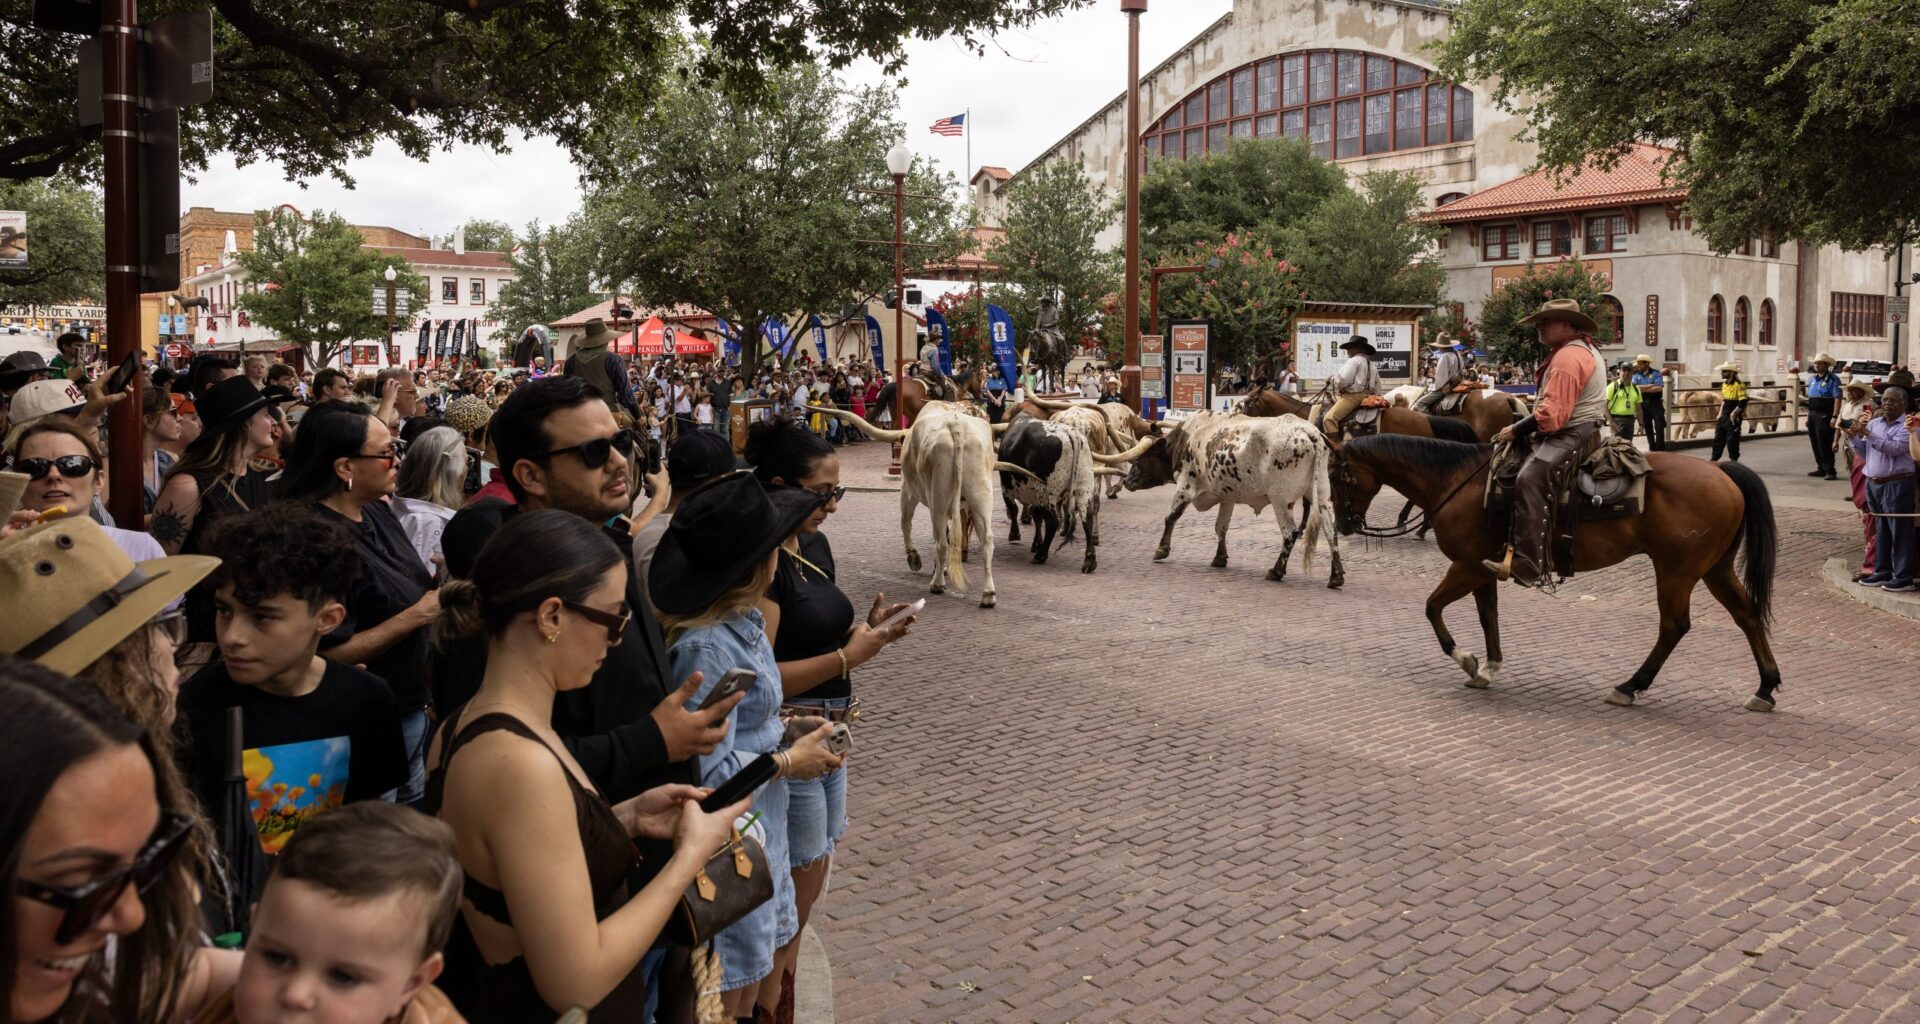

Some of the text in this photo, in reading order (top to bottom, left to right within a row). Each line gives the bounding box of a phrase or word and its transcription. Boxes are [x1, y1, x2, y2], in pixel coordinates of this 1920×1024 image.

[39, 307, 73, 318] STOCK
[1648, 301, 1656, 324] RODEO
[1648, 326, 1656, 345] SHOP
[1376, 342, 1393, 350] WEST
